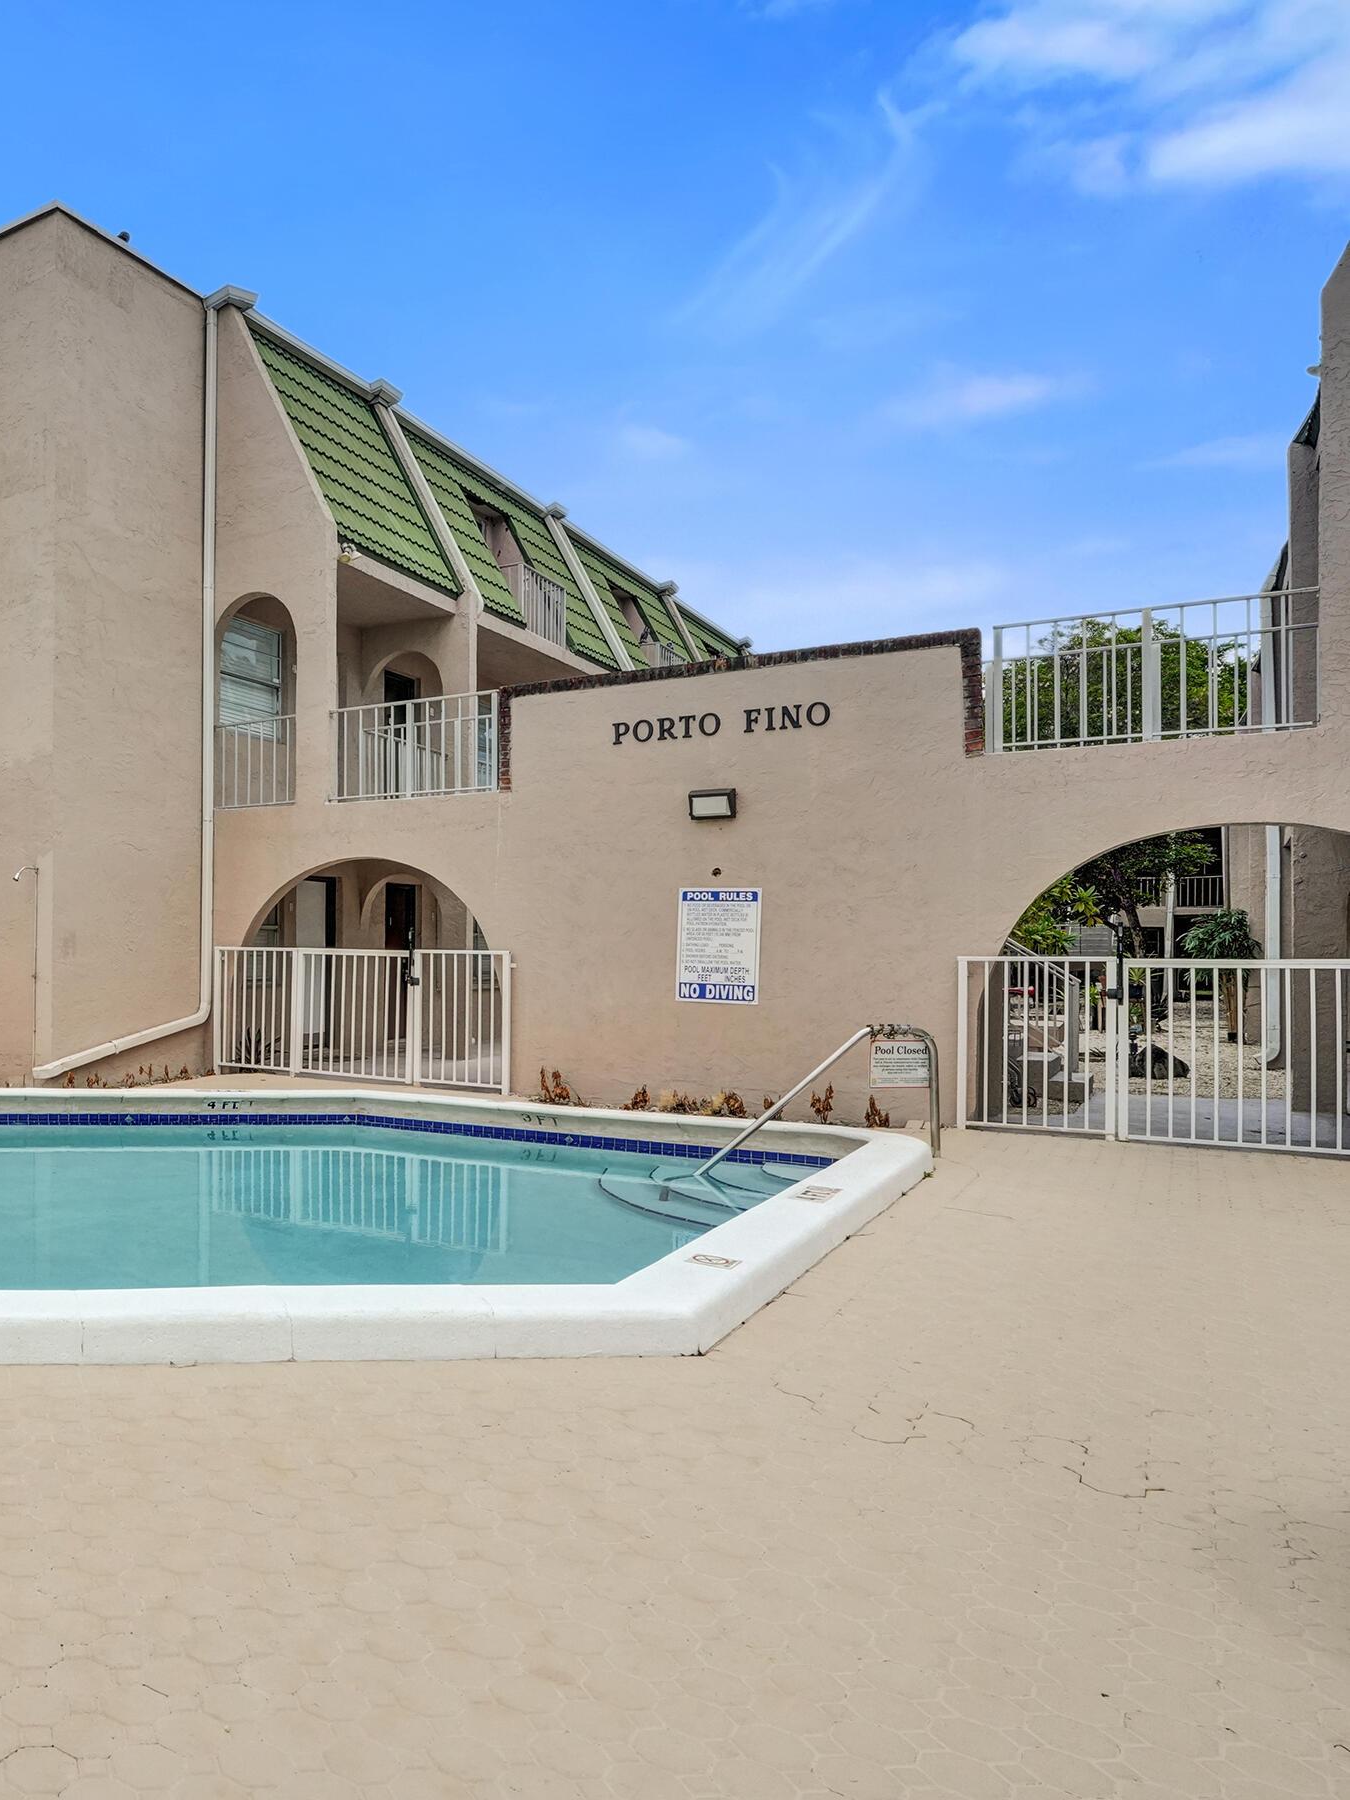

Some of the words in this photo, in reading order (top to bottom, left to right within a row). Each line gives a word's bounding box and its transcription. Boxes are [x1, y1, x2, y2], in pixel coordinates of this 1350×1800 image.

[611, 712, 721, 745] PORTO
[743, 701, 831, 733] FINO
[687, 892, 714, 901] POOL
[719, 892, 754, 901] RULES
[684, 965, 700, 974] POOL
[701, 965, 729, 974] MAXIMUM
[680, 983, 700, 998] NO
[705, 984, 754, 1001] DIVING
[874, 1046, 894, 1055] Pool
[896, 1046, 928, 1055] Closed
[207, 1101, 216, 1109] 4
[536, 1115, 559, 1127] FT
